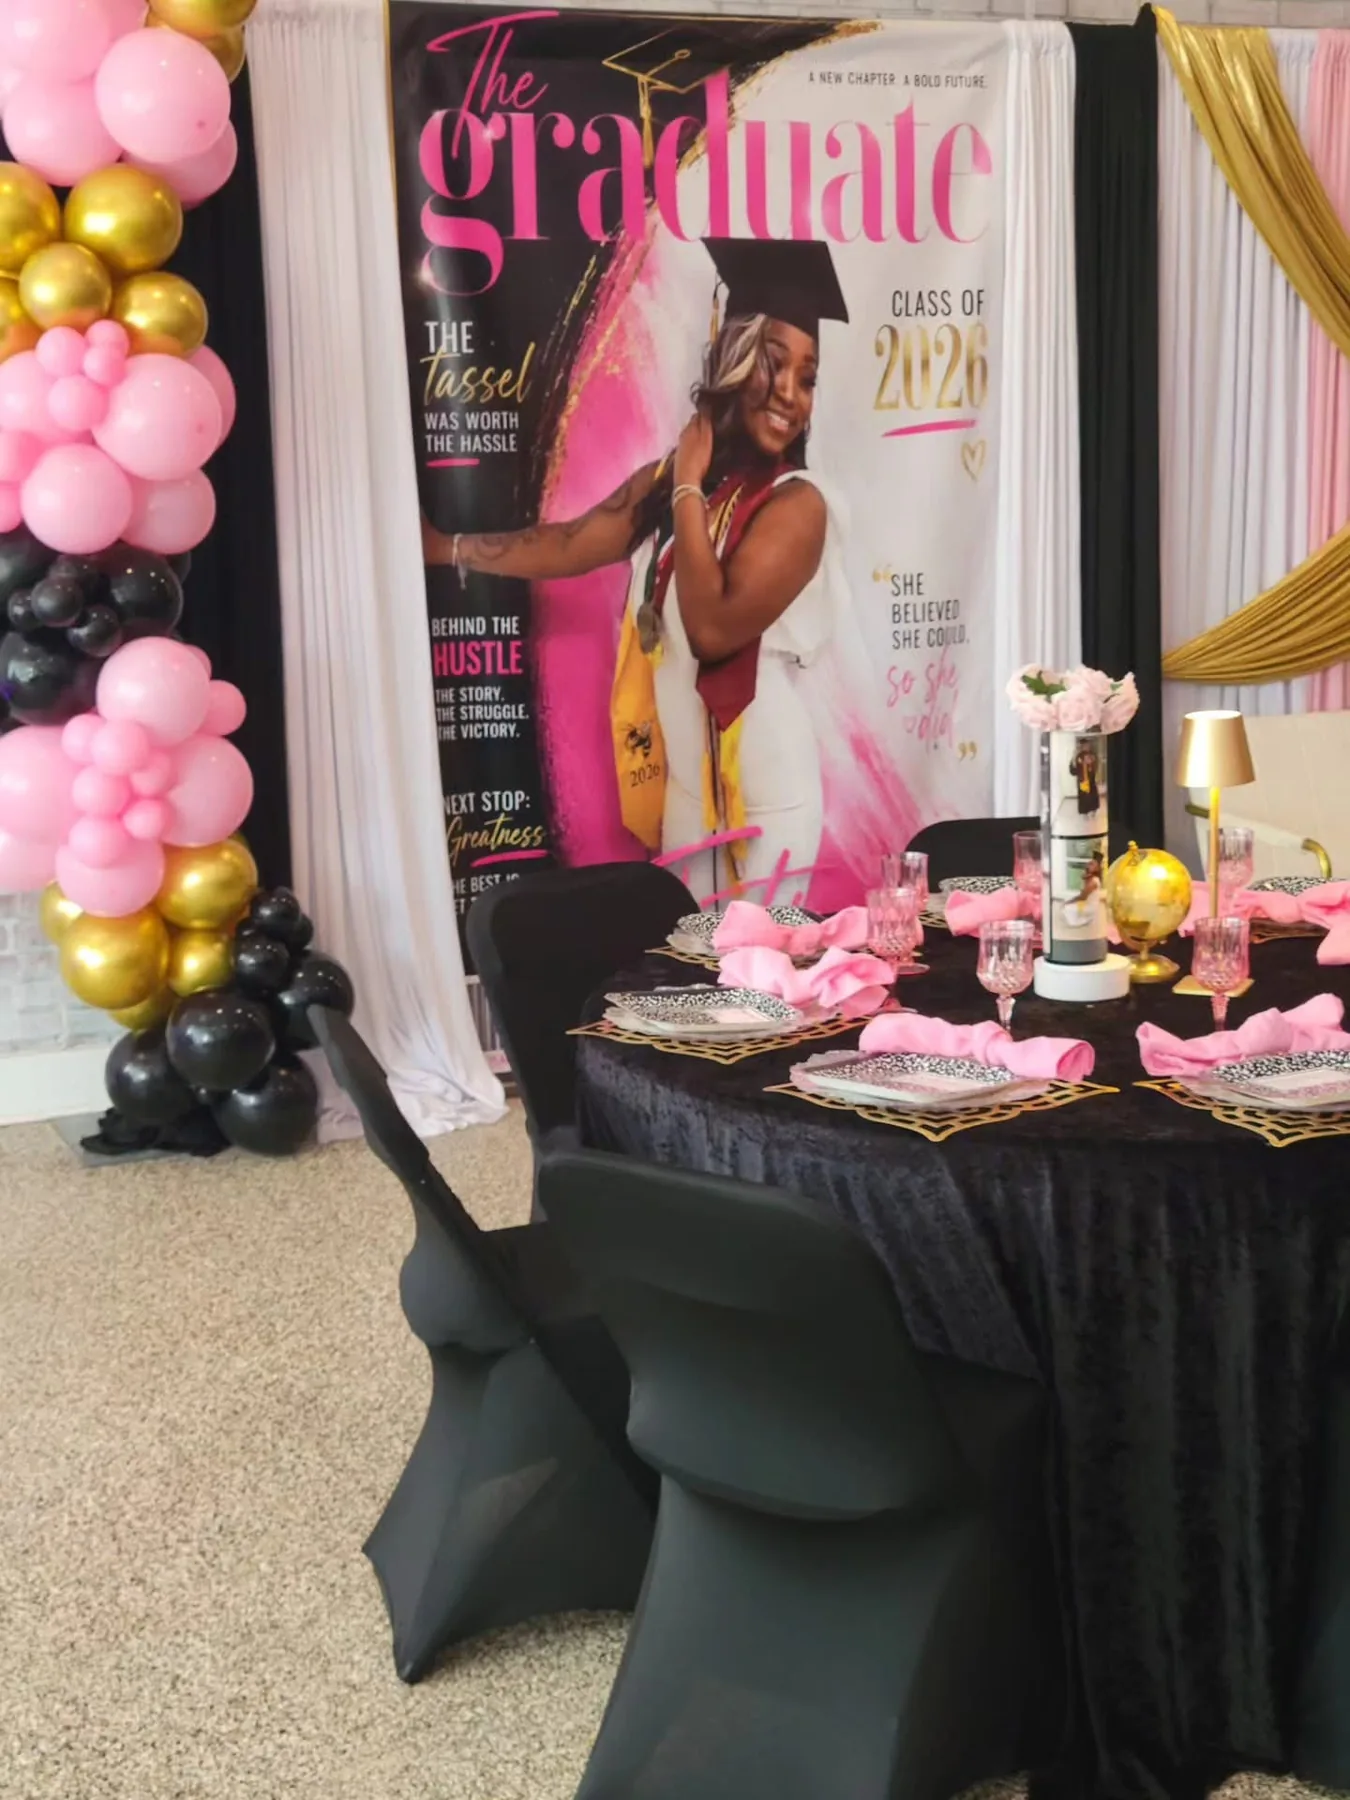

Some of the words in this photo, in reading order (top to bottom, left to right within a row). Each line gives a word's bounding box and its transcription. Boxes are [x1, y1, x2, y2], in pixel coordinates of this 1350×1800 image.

[426, 10, 559, 159] The
[808, 71, 815, 83] A
[819, 71, 842, 84] NEW
[903, 74, 910, 86] A
[914, 74, 940, 88] BOLD
[419, 67, 992, 296] graduate
[892, 289, 952, 317] CLASS
[961, 289, 984, 317] OF
[424, 321, 474, 354] THE
[873, 323, 988, 411] 2026
[424, 412, 459, 430] WAS
[465, 411, 519, 430] WORTH
[425, 435, 454, 452] THE
[460, 434, 518, 452] HASSLE
[892, 599, 960, 624] BELIEVED
[431, 616, 486, 637] BEHIND
[492, 616, 520, 635] THE
[892, 630, 921, 650] SHE
[432, 640, 523, 676] HUSTLE
[435, 688, 455, 704] THE
[459, 686, 505, 702] STORY.
[436, 706, 456, 722] THE
[460, 704, 529, 720] STRUGGLE.
[461, 723, 520, 739] VICTORY.
[630, 763, 660, 788] 2026
[481, 790, 531, 812] STOP:
[447, 812, 546, 867] Greatness
